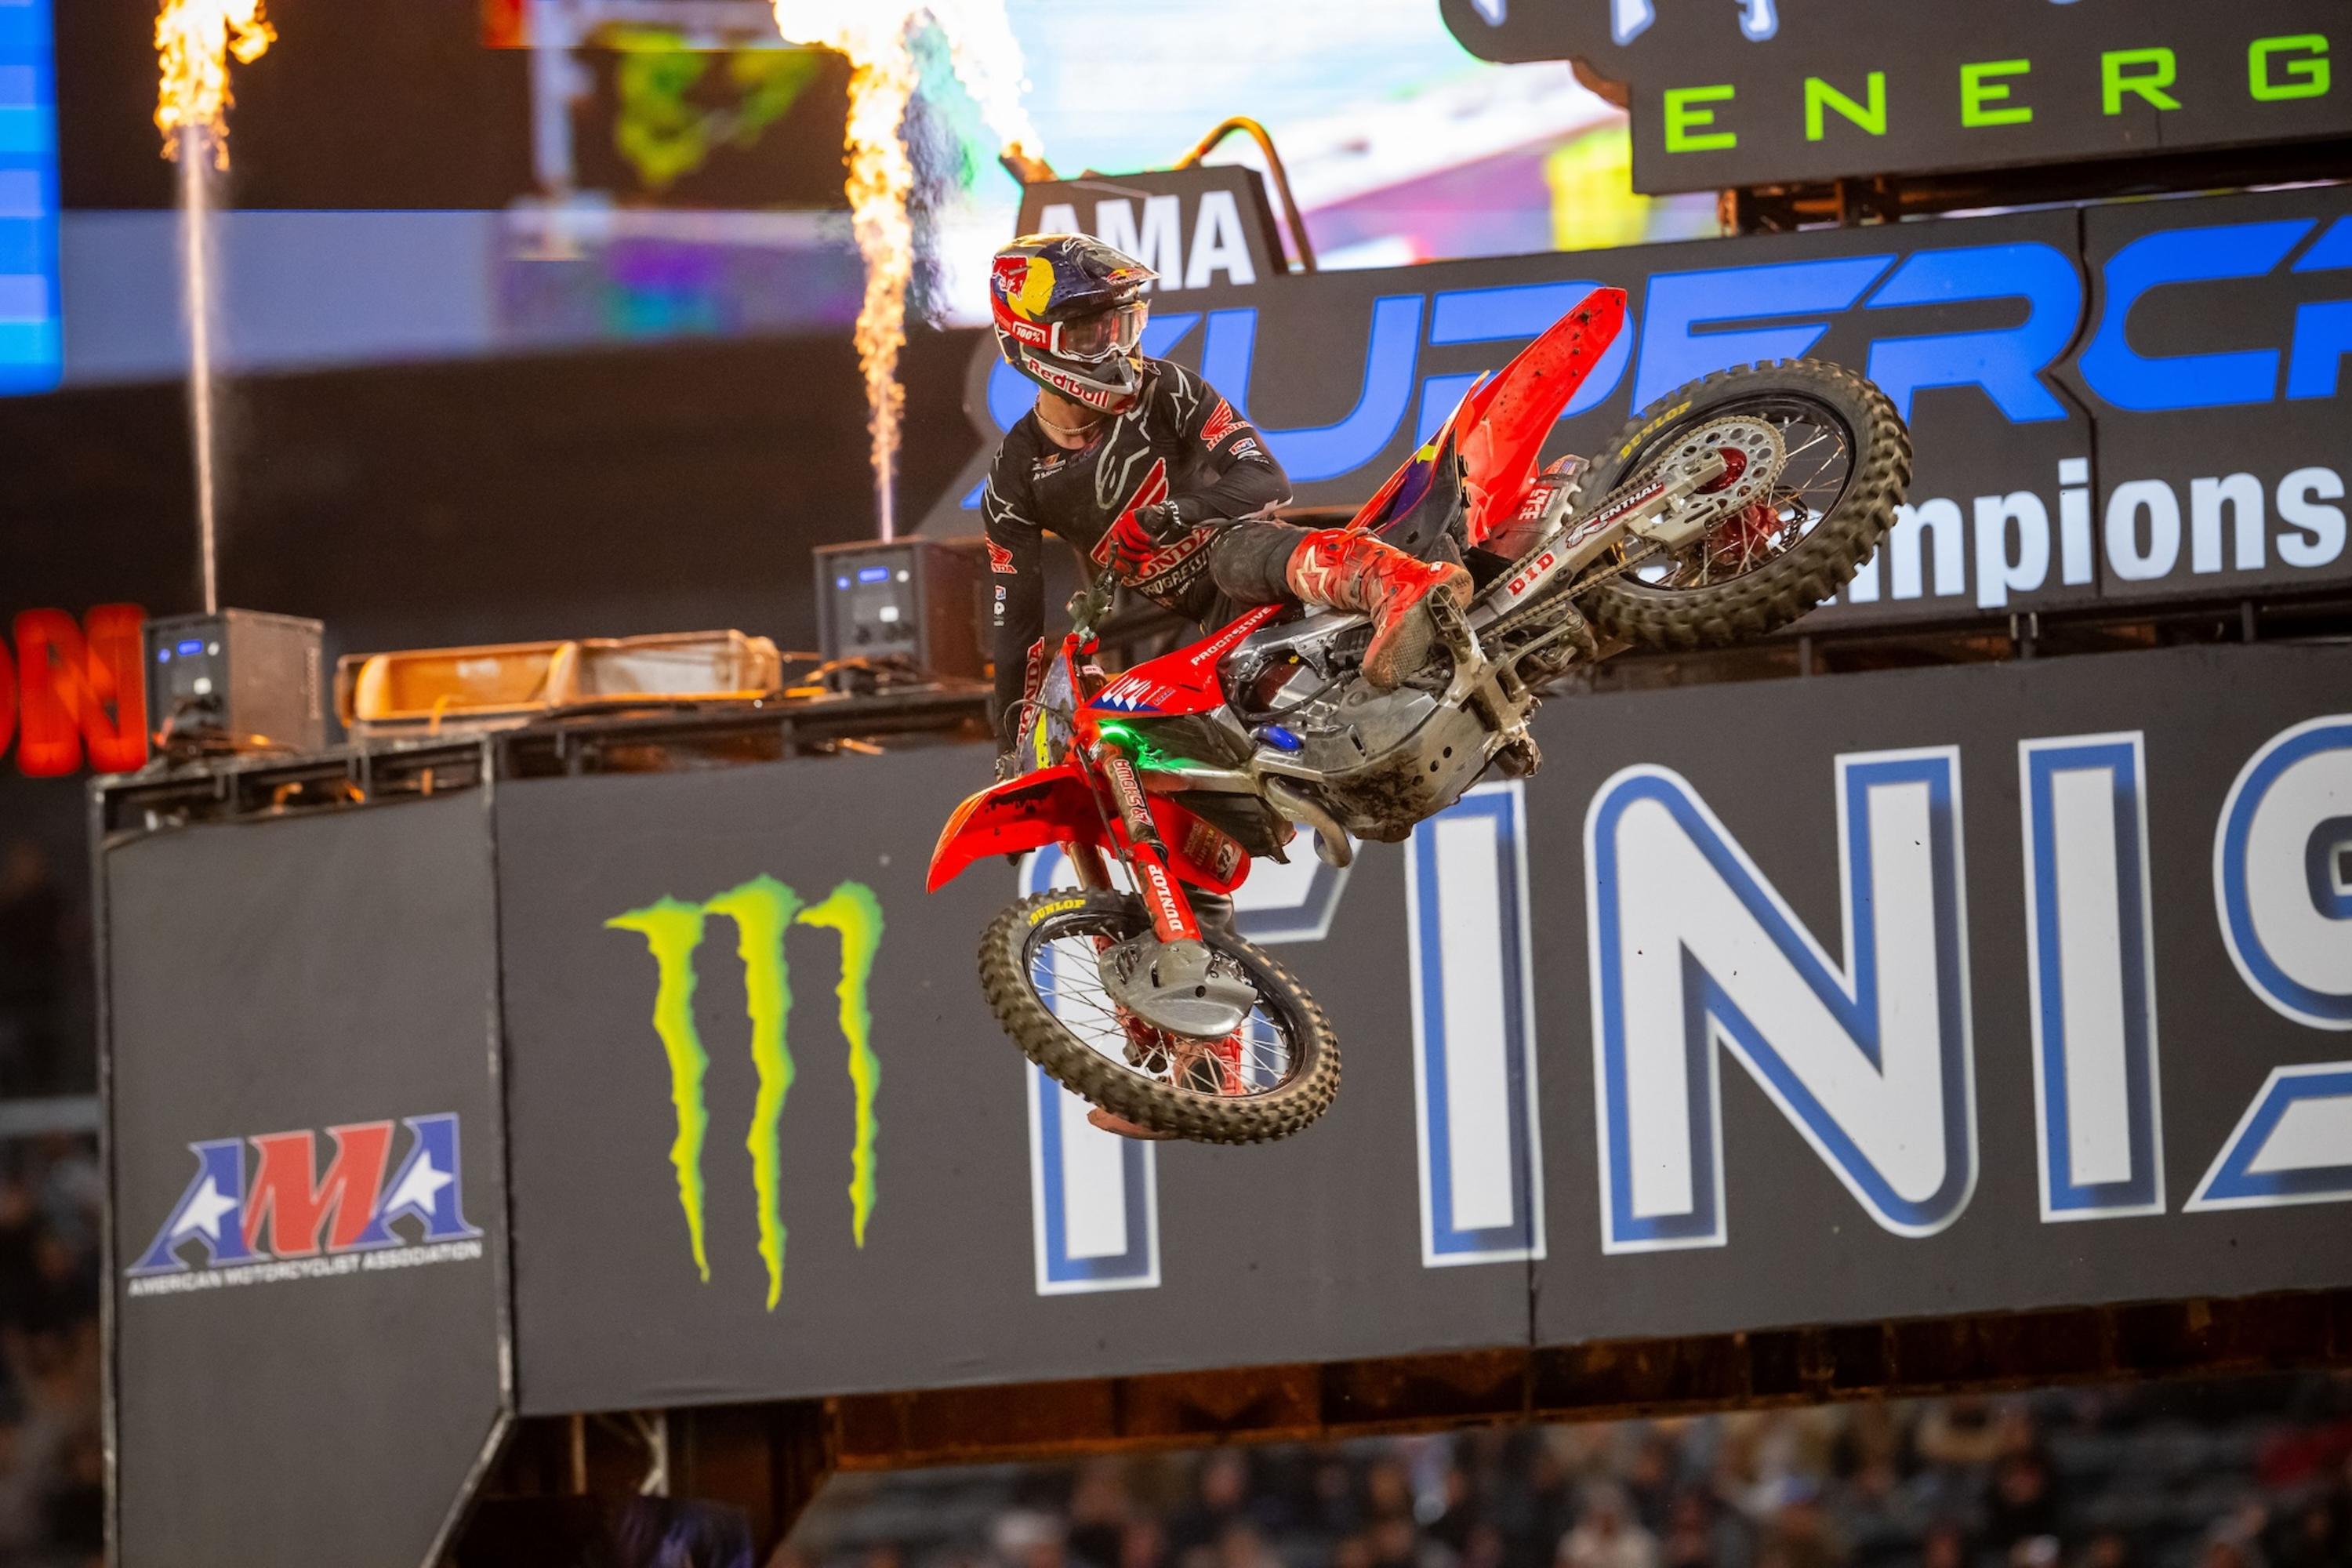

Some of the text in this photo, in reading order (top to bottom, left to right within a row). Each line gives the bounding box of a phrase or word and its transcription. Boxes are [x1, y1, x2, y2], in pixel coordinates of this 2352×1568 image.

[1664, 34, 2330, 152] ENERG
[1014, 325, 1042, 343] 100%
[1027, 358, 1109, 409] Red Bull
[1619, 401, 1692, 460] DUNLOP
[1123, 524, 1220, 586] ONDA
[1819, 459, 2346, 610] mpions
[991, 563, 1018, 574] NDA
[1190, 607, 1272, 666] PROGRESSIVE
[1029, 898, 1086, 926] DUNLOP
[1147, 864, 1185, 931] DUNLOP
[124, 1111, 485, 1277] AMA
[128, 1241, 483, 1297] AMERICAN MOTORCYCLIST ASSOCIATION
